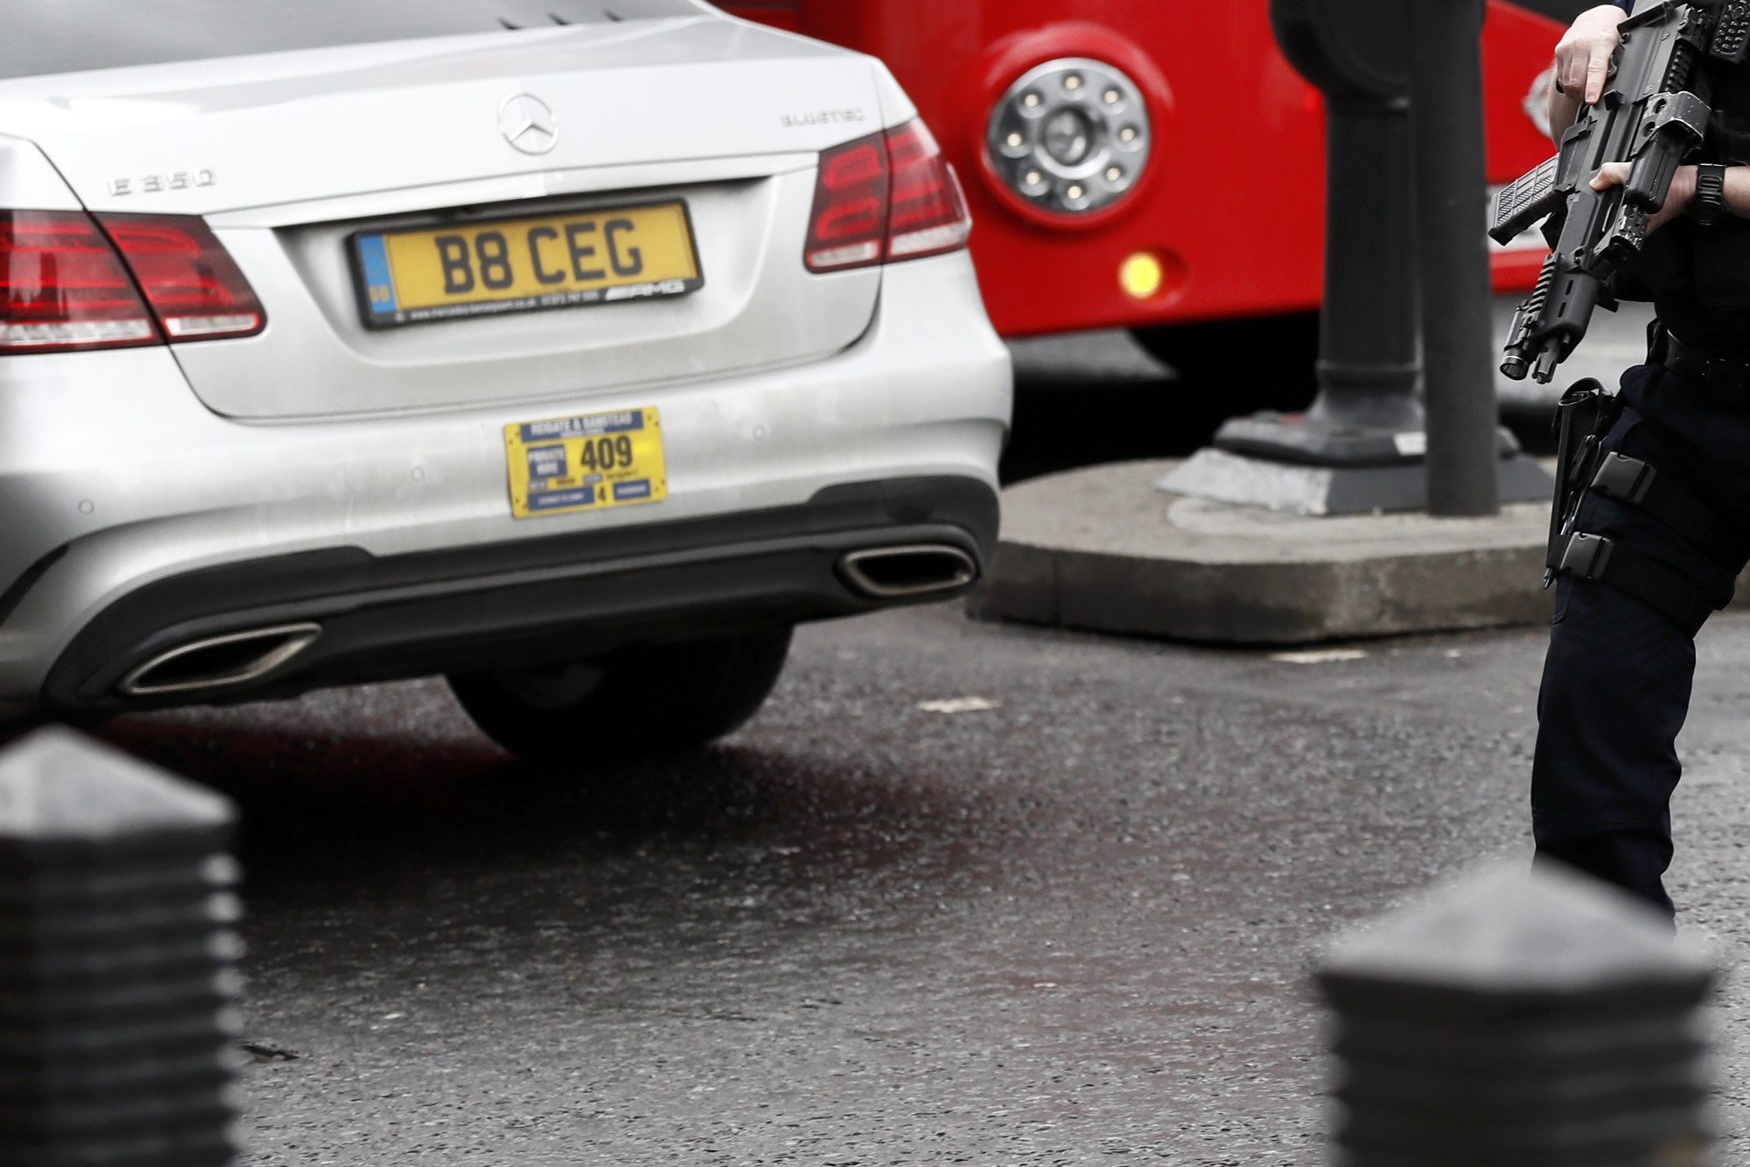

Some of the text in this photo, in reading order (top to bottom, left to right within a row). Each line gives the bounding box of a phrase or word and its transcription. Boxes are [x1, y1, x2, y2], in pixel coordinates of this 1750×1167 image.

[106, 168, 217, 197] E 350
[434, 218, 644, 295] B8 CEG
[581, 434, 633, 471] 409
